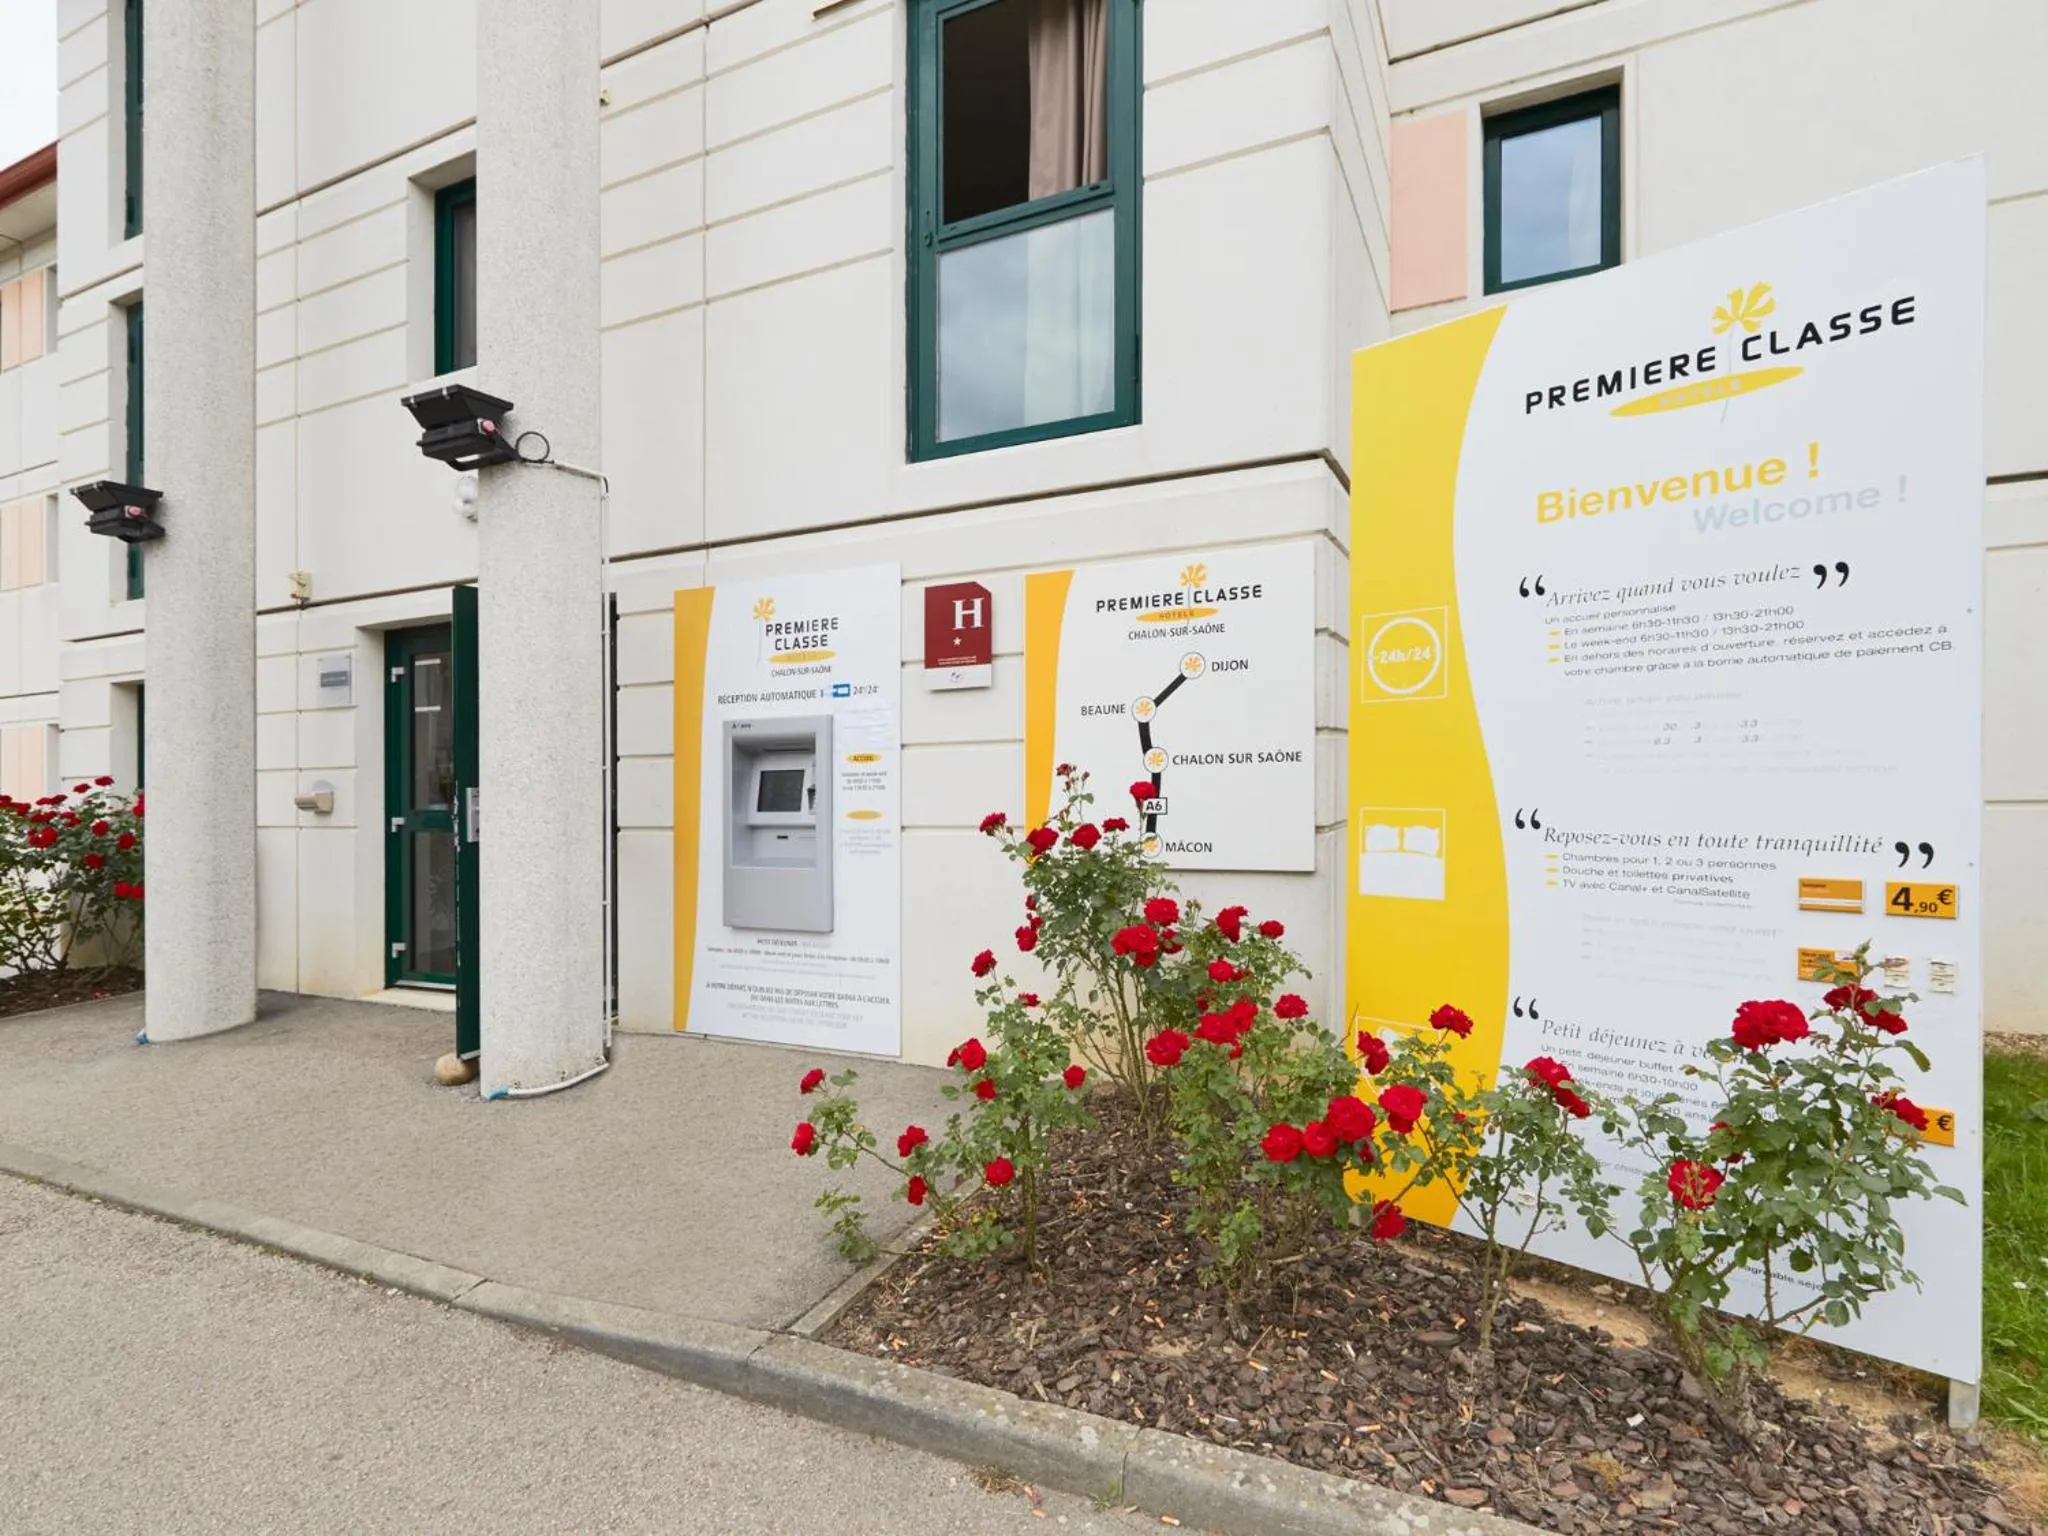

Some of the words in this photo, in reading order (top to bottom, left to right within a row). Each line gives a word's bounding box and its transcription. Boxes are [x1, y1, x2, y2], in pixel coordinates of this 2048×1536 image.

[1525, 346, 1717, 414] PREMIERE
[1741, 296, 1916, 361] CLASSE
[1536, 456, 1786, 524] Bienvenue
[1693, 480, 1882, 534] Welcome
[1546, 588, 1611, 607] Arrivez
[1616, 577, 1675, 604] quand
[1681, 577, 1726, 592] vous
[1734, 563, 1800, 586] voulez
[1096, 591, 1184, 613] PREMIERE
[1193, 584, 1262, 604] CLASSE
[952, 597, 984, 630] H
[765, 617, 839, 636] PREMIERE
[1128, 622, 1225, 641] CHALON-SUR-SAÔNE
[1722, 620, 1804, 635] 13h30-21h00
[775, 634, 828, 651] CLASSE
[1849, 632, 1862, 640] et
[1834, 650, 1852, 658] de
[1856, 644, 1924, 658] paiement
[1211, 659, 1249, 672] DIJON
[760, 690, 817, 702] AUTOMATIQUE
[1081, 703, 1126, 716] BEAUNE
[1172, 753, 1224, 766] CHALON
[1228, 752, 1252, 764] SUR
[1258, 749, 1302, 763] SAÔNE
[1146, 801, 1162, 812] A6
[1165, 839, 1212, 852] MÂCON
[1544, 827, 1661, 848] Reposez-vous
[1668, 834, 1689, 847] en
[1698, 834, 1750, 849] toute
[1756, 833, 1884, 855] tranquillité
[1562, 853, 1619, 863] Chambres
[1622, 857, 1649, 865] pour
[1665, 858, 1673, 866] 2
[1676, 859, 1692, 867] ou
[1697, 859, 1704, 867] 3
[1707, 860, 1776, 871] personnes
[1562, 866, 1604, 876] Douche
[1608, 869, 1618, 877] et
[1622, 869, 1668, 880] toilettes
[1672, 872, 1734, 884] privatives
[1562, 879, 1576, 889] TV
[1667, 885, 1751, 900] CanalSatellite
[1542, 1019, 1581, 1040] Petit
[1589, 1028, 1667, 1053] déjeunez
[1578, 1065, 1624, 1079] semaine
[1639, 1059, 1673, 1073] buffet
